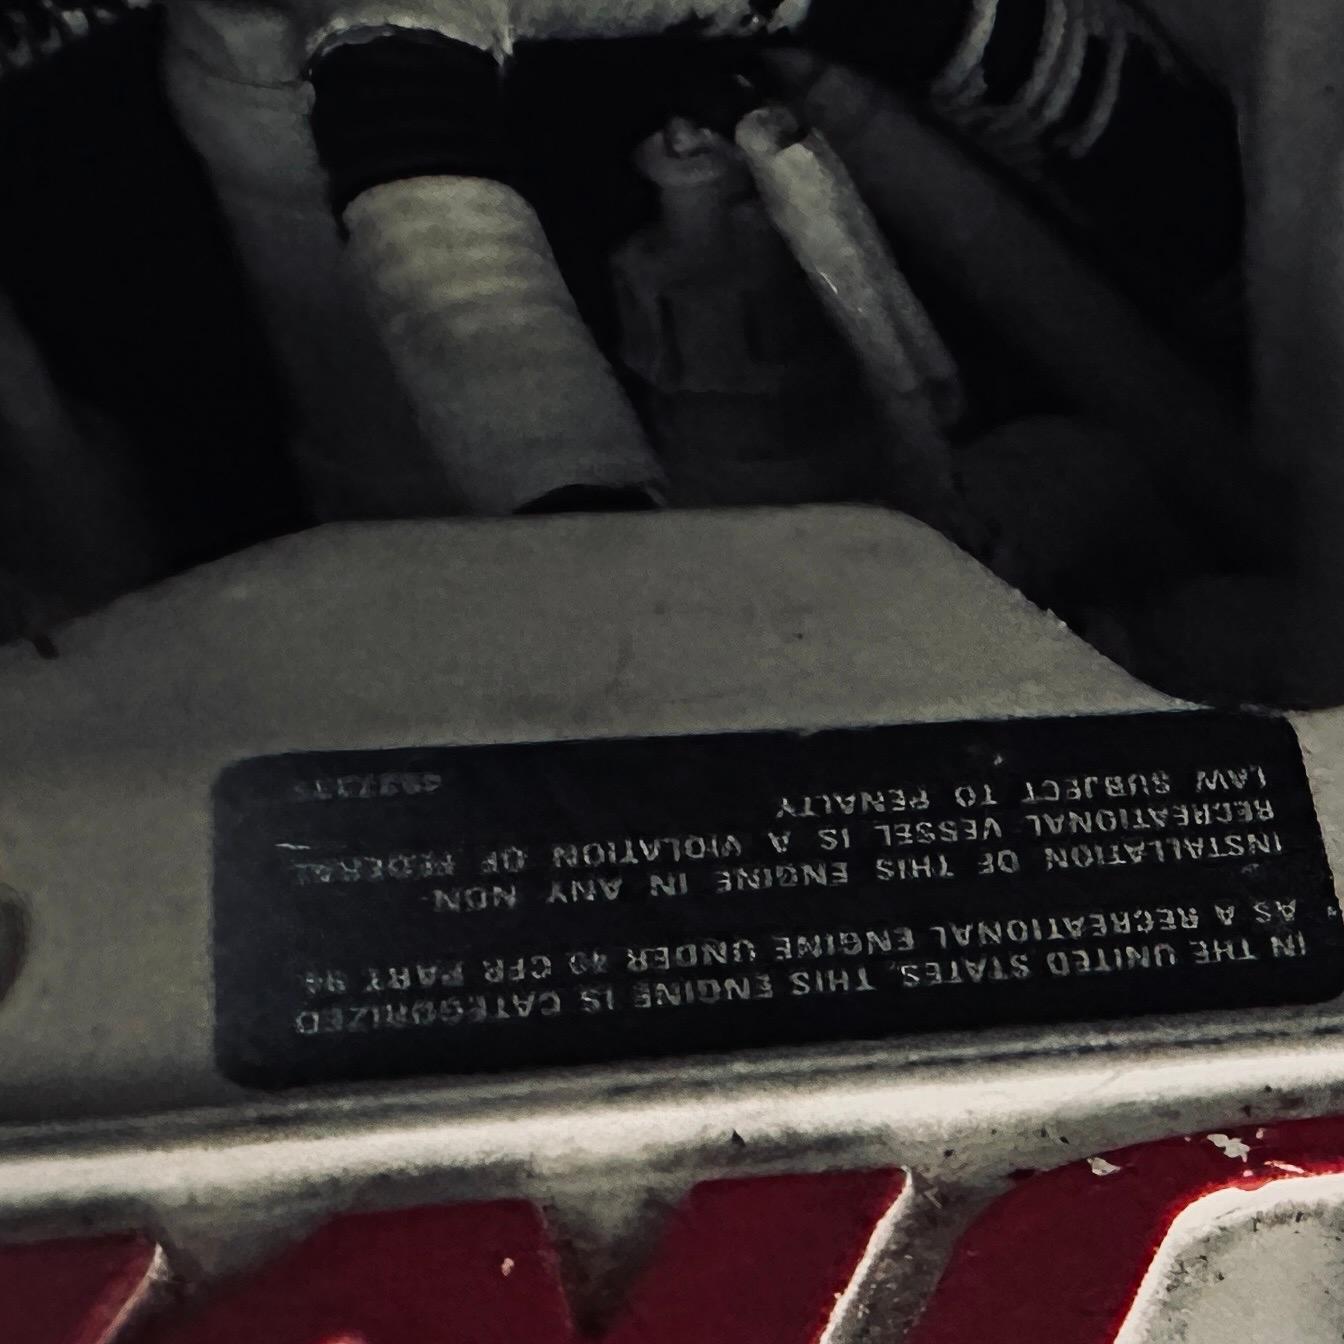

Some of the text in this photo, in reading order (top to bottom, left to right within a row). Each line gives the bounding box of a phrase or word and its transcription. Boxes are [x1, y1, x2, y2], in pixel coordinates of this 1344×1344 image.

[775, 765, 1267, 819] LAW SUBJECT TO PENALTY
[873, 816, 1003, 847] VESSEL
[1024, 798, 1275, 837] RECREATIONAL
[552, 834, 742, 868] VIOLATION
[767, 830, 791, 854] A
[817, 827, 851, 851] IS
[1043, 831, 1283, 871] INSTALLATION
[482, 846, 528, 873] OF
[875, 853, 955, 882] THIS
[977, 848, 1020, 875] OF
[546, 877, 623, 904] ANY
[649, 872, 688, 897] IN
[715, 861, 849, 893] ENGINE
[1213, 904, 1236, 927] A
[1252, 898, 1297, 924] AS
[930, 906, 1200, 949] RECREATIONAL
[626, 938, 757, 972] UNDER
[772, 926, 915, 961] ENGINE
[1188, 937, 1258, 965] THE
[1269, 930, 1307, 958] IN
[482, 955, 552, 983] CFR
[1046, 942, 1177, 977] UNITED
[635, 973, 774, 1009] ENGINE
[789, 966, 876, 996] THIS
[580, 987, 614, 1013] IS
